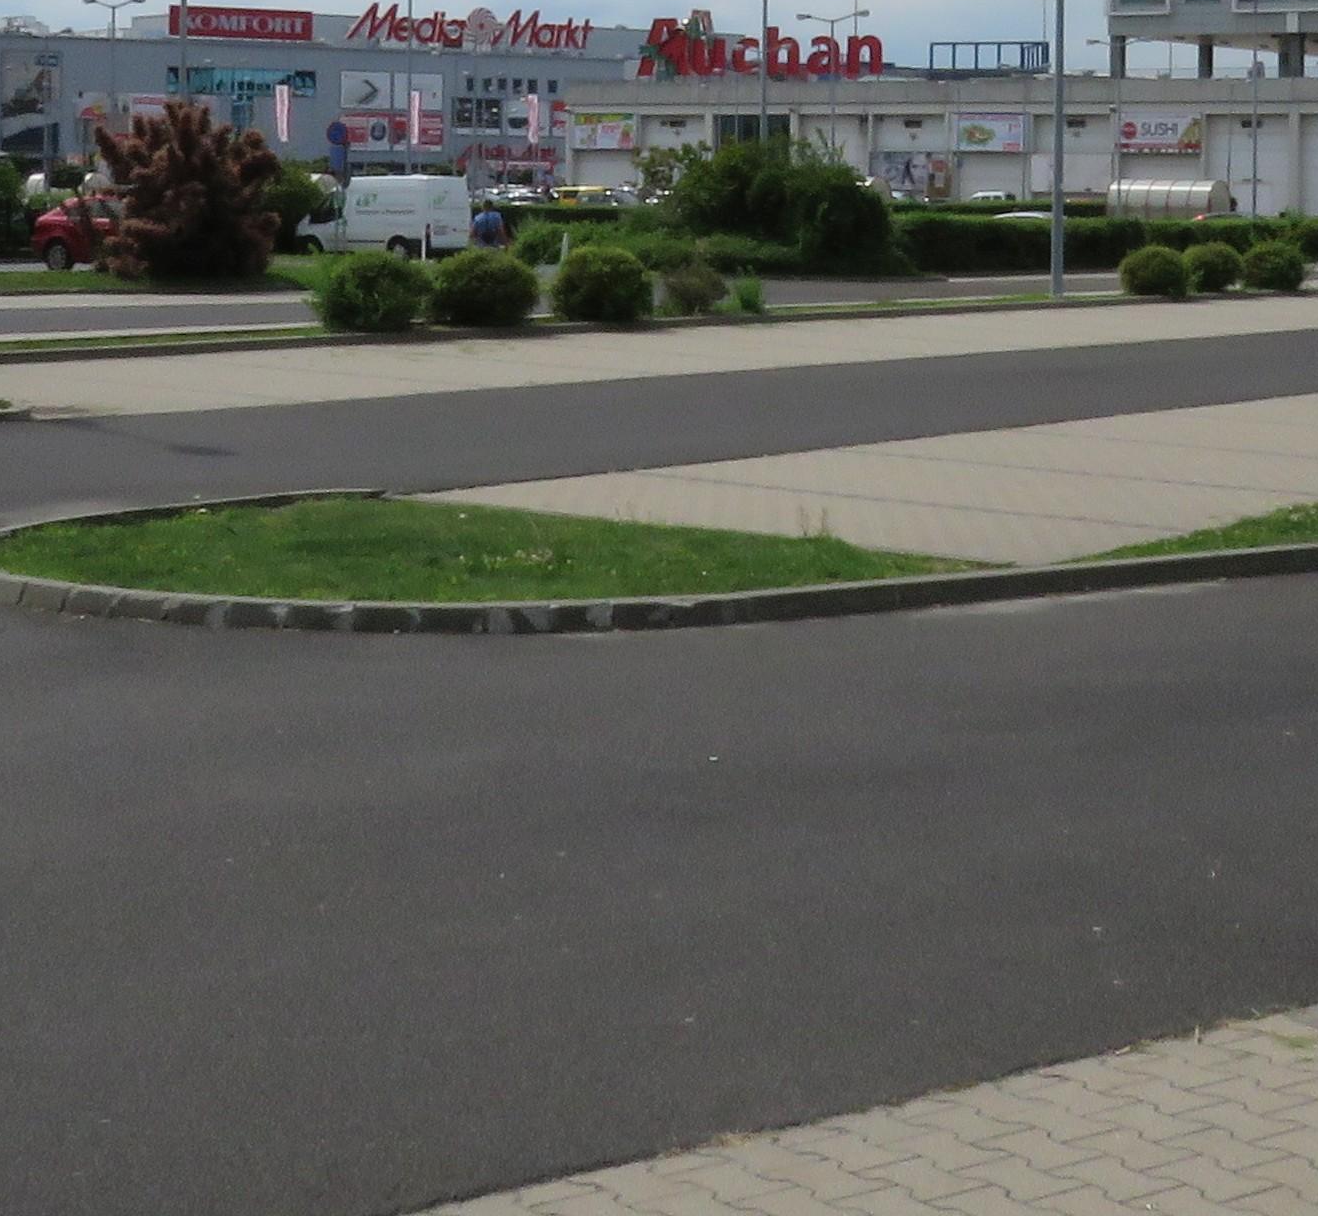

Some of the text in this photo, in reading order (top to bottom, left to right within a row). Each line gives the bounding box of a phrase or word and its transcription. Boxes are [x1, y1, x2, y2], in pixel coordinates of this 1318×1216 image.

[346, 2, 595, 50] Media Markt
[638, 13, 884, 80] Auchan
